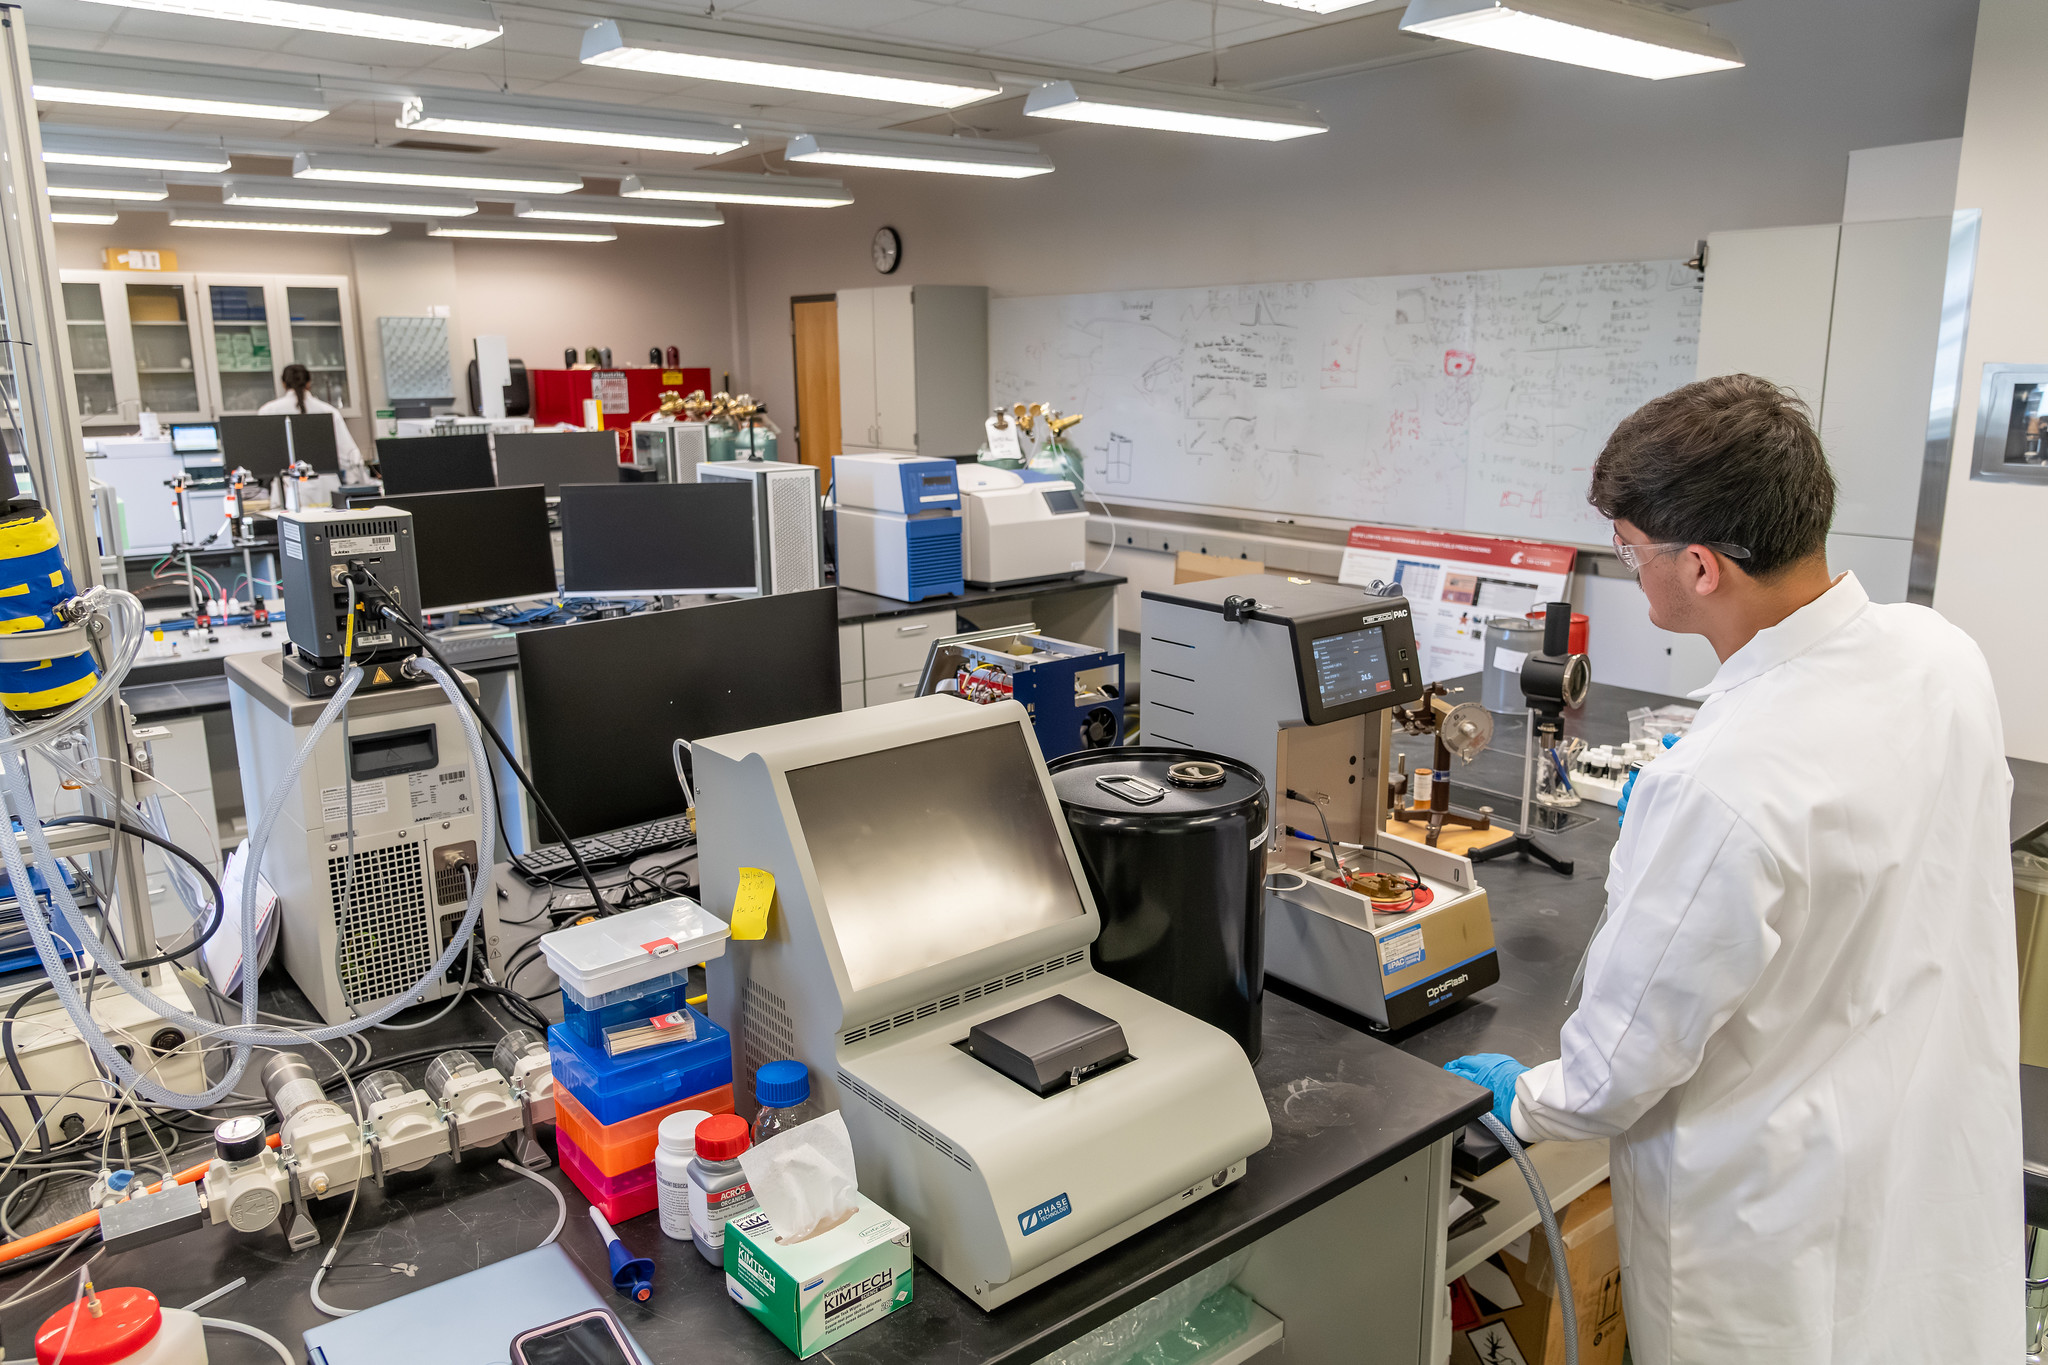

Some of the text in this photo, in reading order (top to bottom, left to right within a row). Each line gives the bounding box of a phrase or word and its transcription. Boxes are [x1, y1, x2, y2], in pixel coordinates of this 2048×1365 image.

[1393, 609, 1408, 620] PAC
[1391, 958, 1405, 968] PAC
[1426, 973, 1469, 998] OptiFlash
[720, 1185, 746, 1201] ACROS
[720, 1193, 747, 1207] ORGANICS
[1037, 1197, 1068, 1217] PHASE
[1040, 1205, 1069, 1222] TECHNOLOGY
[736, 1213, 768, 1229] KIMT
[738, 1247, 776, 1288] KIMTECH
[824, 1281, 852, 1298] Kimwipes
[824, 1268, 892, 1312] KIMTECH
